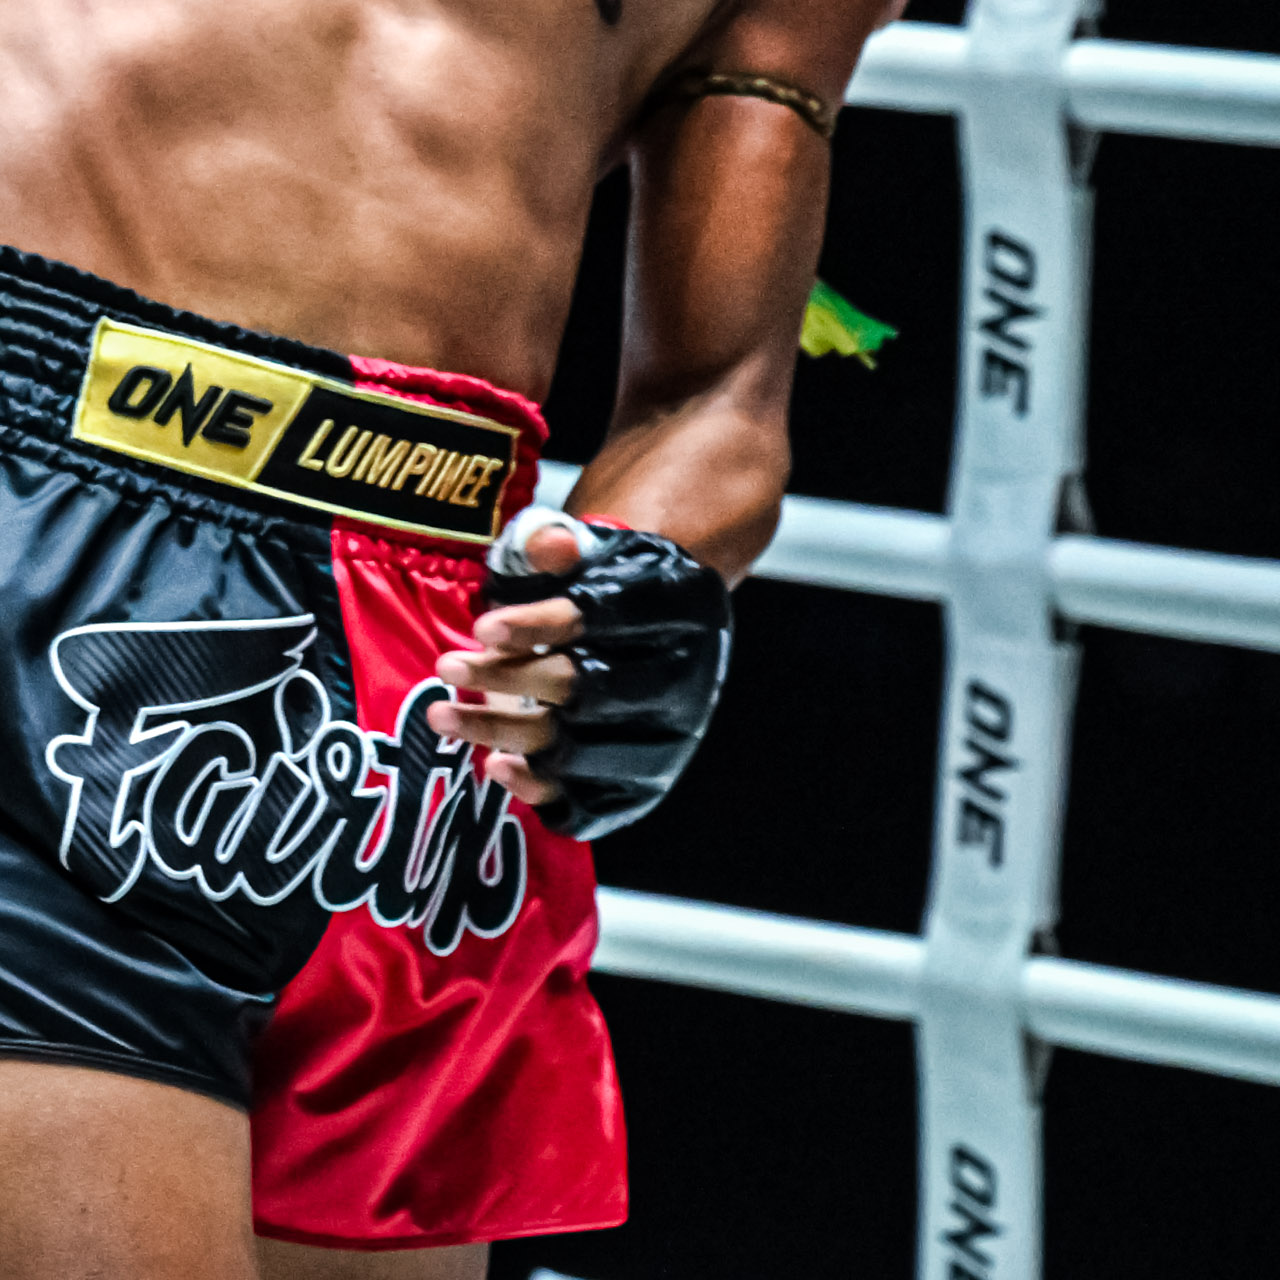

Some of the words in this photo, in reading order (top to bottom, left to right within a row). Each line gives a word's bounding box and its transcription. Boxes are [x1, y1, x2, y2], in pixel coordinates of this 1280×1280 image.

[977, 229, 1046, 418] ONE
[107, 362, 274, 452] ONE
[297, 418, 504, 508] LUMPINEE
[956, 678, 1021, 869] ONE
[939, 1143, 1007, 1280] ON
